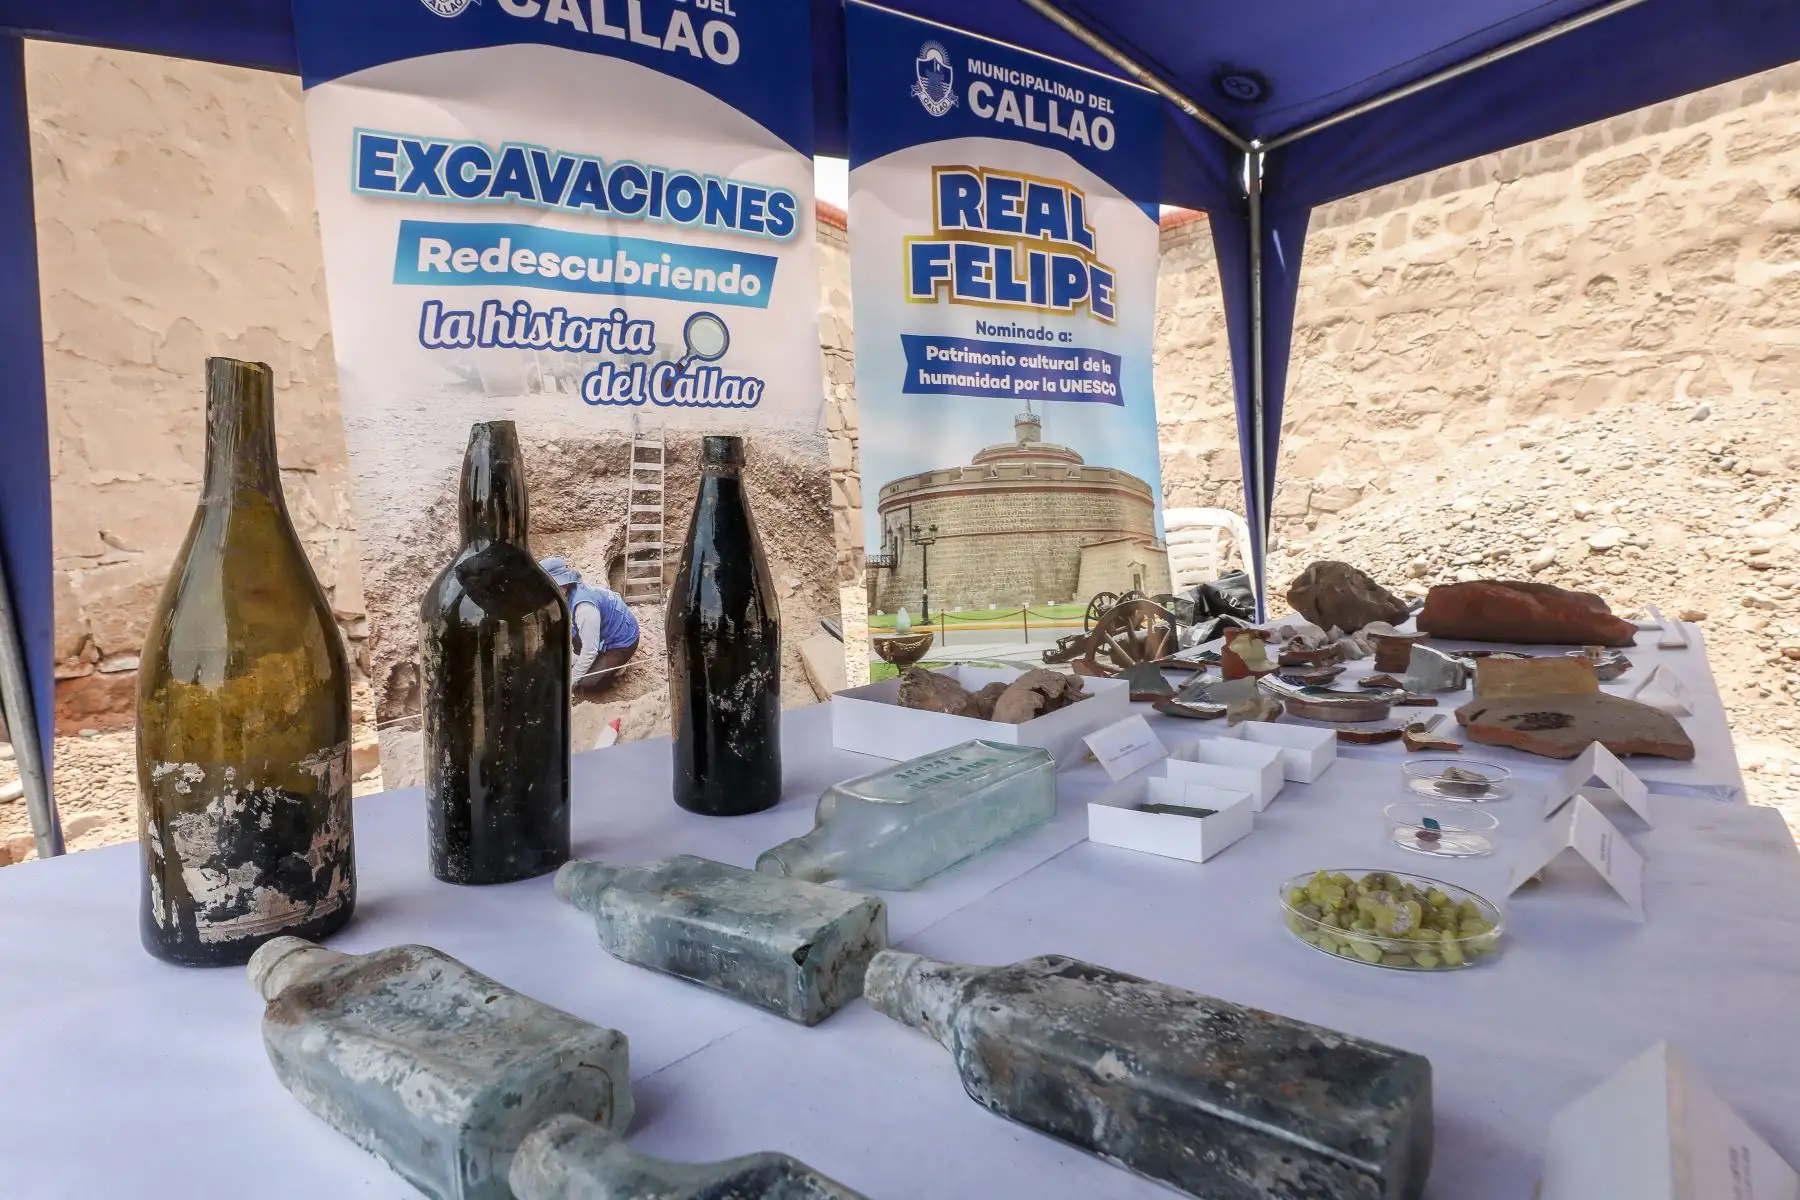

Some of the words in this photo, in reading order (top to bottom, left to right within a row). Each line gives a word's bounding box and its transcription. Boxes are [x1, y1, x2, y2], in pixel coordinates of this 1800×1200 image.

[923, 97, 948, 114] CALLAO
[968, 58, 1085, 105] MUNICIPALIDAD
[1088, 93, 1114, 114] DEL
[968, 81, 1115, 151] CALLAO
[353, 129, 800, 241] EXCAVACIONES
[935, 167, 1096, 255] REAL
[417, 237, 761, 298] Redescubriendo
[906, 237, 1117, 324] FELIPE
[419, 300, 476, 349] la
[477, 299, 655, 354] historia
[975, 320, 1054, 342] Nominado
[1058, 331, 1072, 342] a:
[581, 361, 645, 407] del
[649, 364, 765, 409] Callao
[919, 369, 1010, 390] humanidad
[1014, 379, 1039, 393] por
[1043, 378, 1056, 392] la
[1059, 379, 1117, 397] UNESCO
[926, 346, 1016, 367] Patrimonio
[1019, 354, 1078, 371] cultural
[1083, 357, 1100, 373] de
[1102, 359, 1112, 375] la
